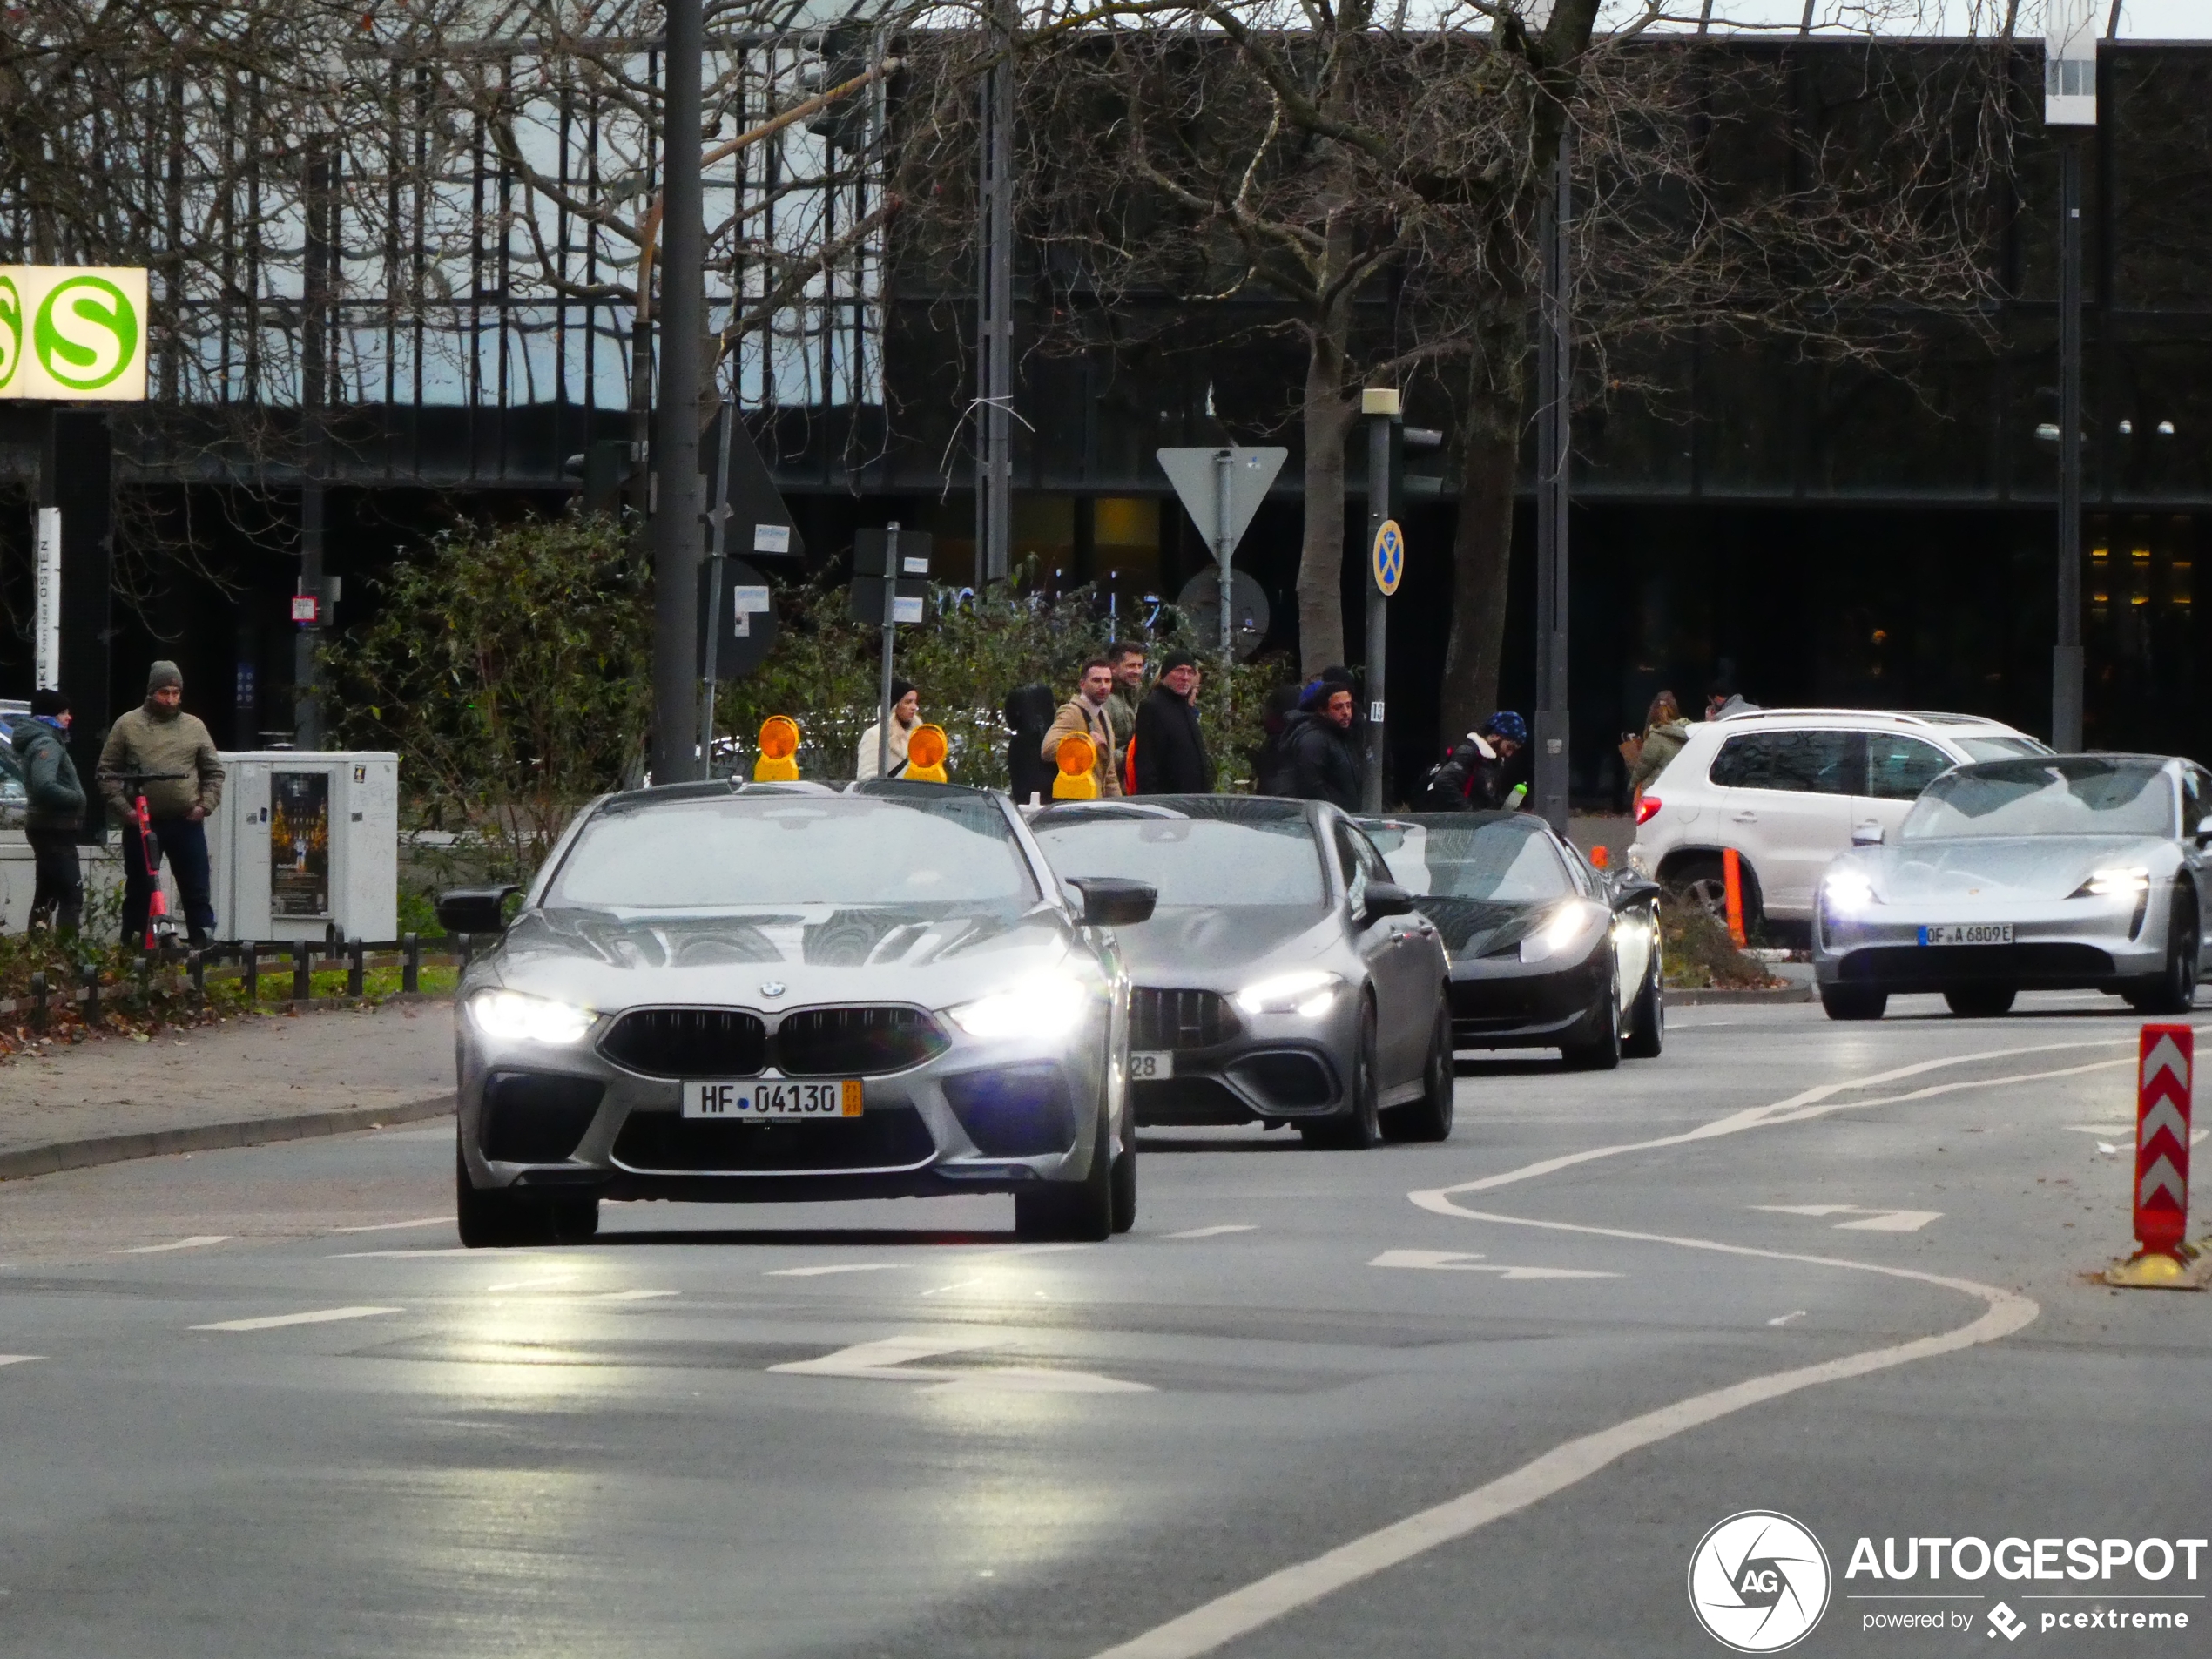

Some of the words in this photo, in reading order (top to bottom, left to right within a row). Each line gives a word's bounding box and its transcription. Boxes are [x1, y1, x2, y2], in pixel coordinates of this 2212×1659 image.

[50, 285, 121, 381] S
[39, 540, 49, 599] OSTEN
[1927, 927, 1944, 942] OF
[1955, 927, 1964, 941] A
[702, 1085, 733, 1112] HF
[754, 1085, 835, 1112] 04130
